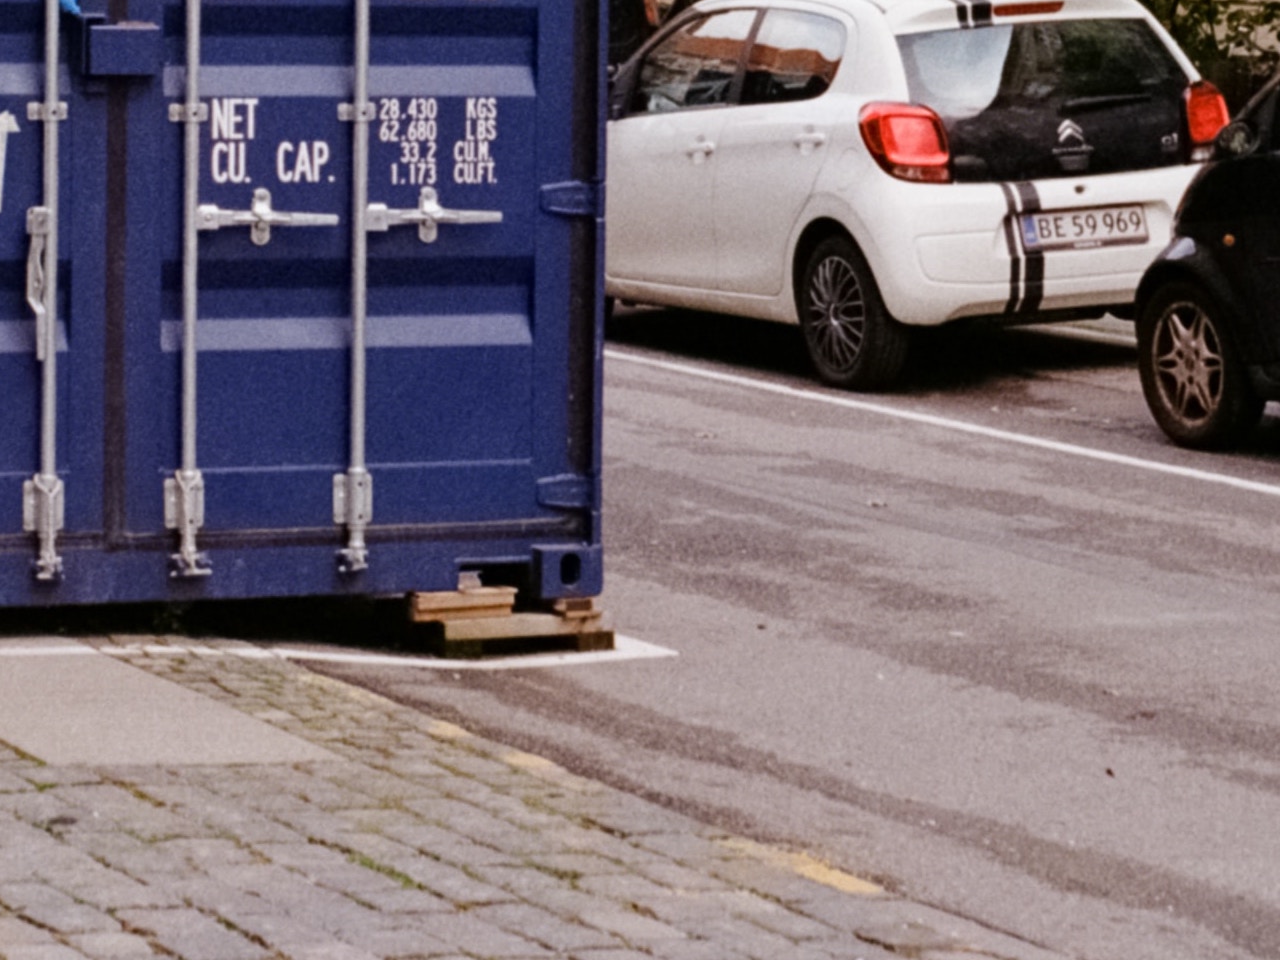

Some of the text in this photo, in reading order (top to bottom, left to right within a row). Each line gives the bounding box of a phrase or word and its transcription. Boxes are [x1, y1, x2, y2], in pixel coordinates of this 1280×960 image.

[211, 98, 259, 139] NET
[380, 97, 497, 120] 28.430 KGS
[380, 120, 497, 141] 62.680 LBS
[211, 141, 336, 184] CU. CAP.
[400, 141, 437, 163] 33.2
[391, 163, 437, 185] 1.173
[1038, 210, 1141, 239] BE 59 969
